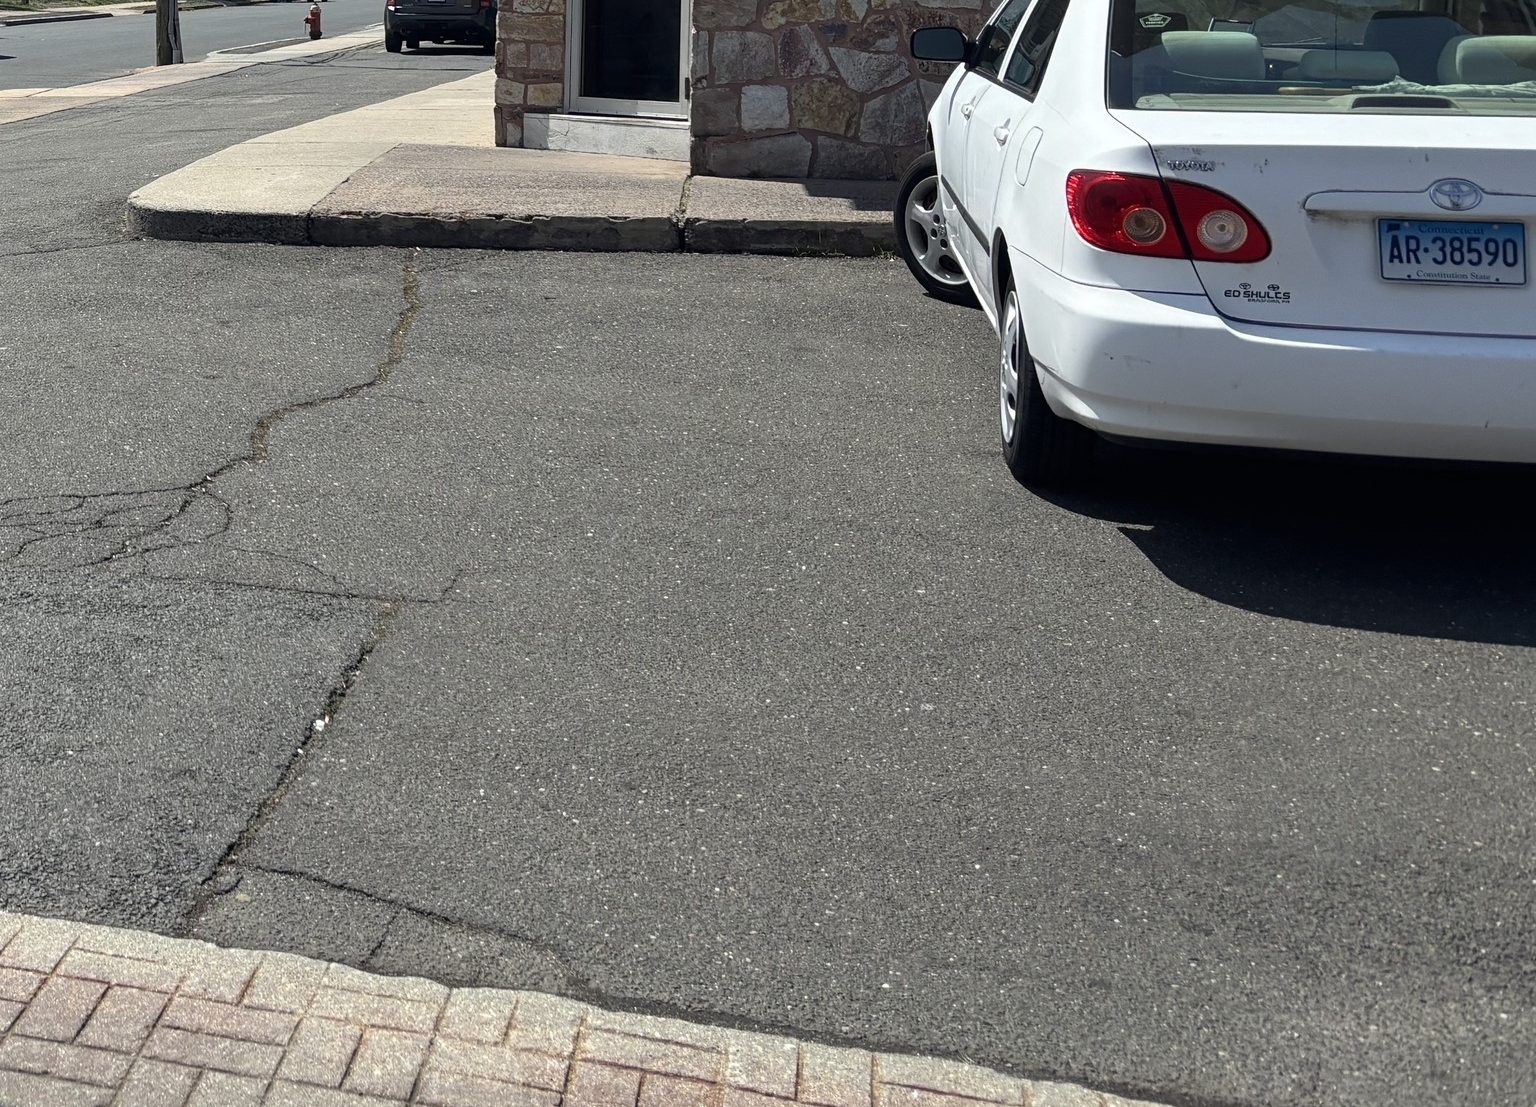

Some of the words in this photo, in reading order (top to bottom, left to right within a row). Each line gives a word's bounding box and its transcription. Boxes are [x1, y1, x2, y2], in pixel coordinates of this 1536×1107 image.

[1167, 160, 1215, 172] TOYOTA
[1418, 223, 1485, 235] Connecticut
[1415, 269, 1468, 279] Constitution
[1470, 271, 1491, 280] State
[1224, 289, 1241, 298] ED
